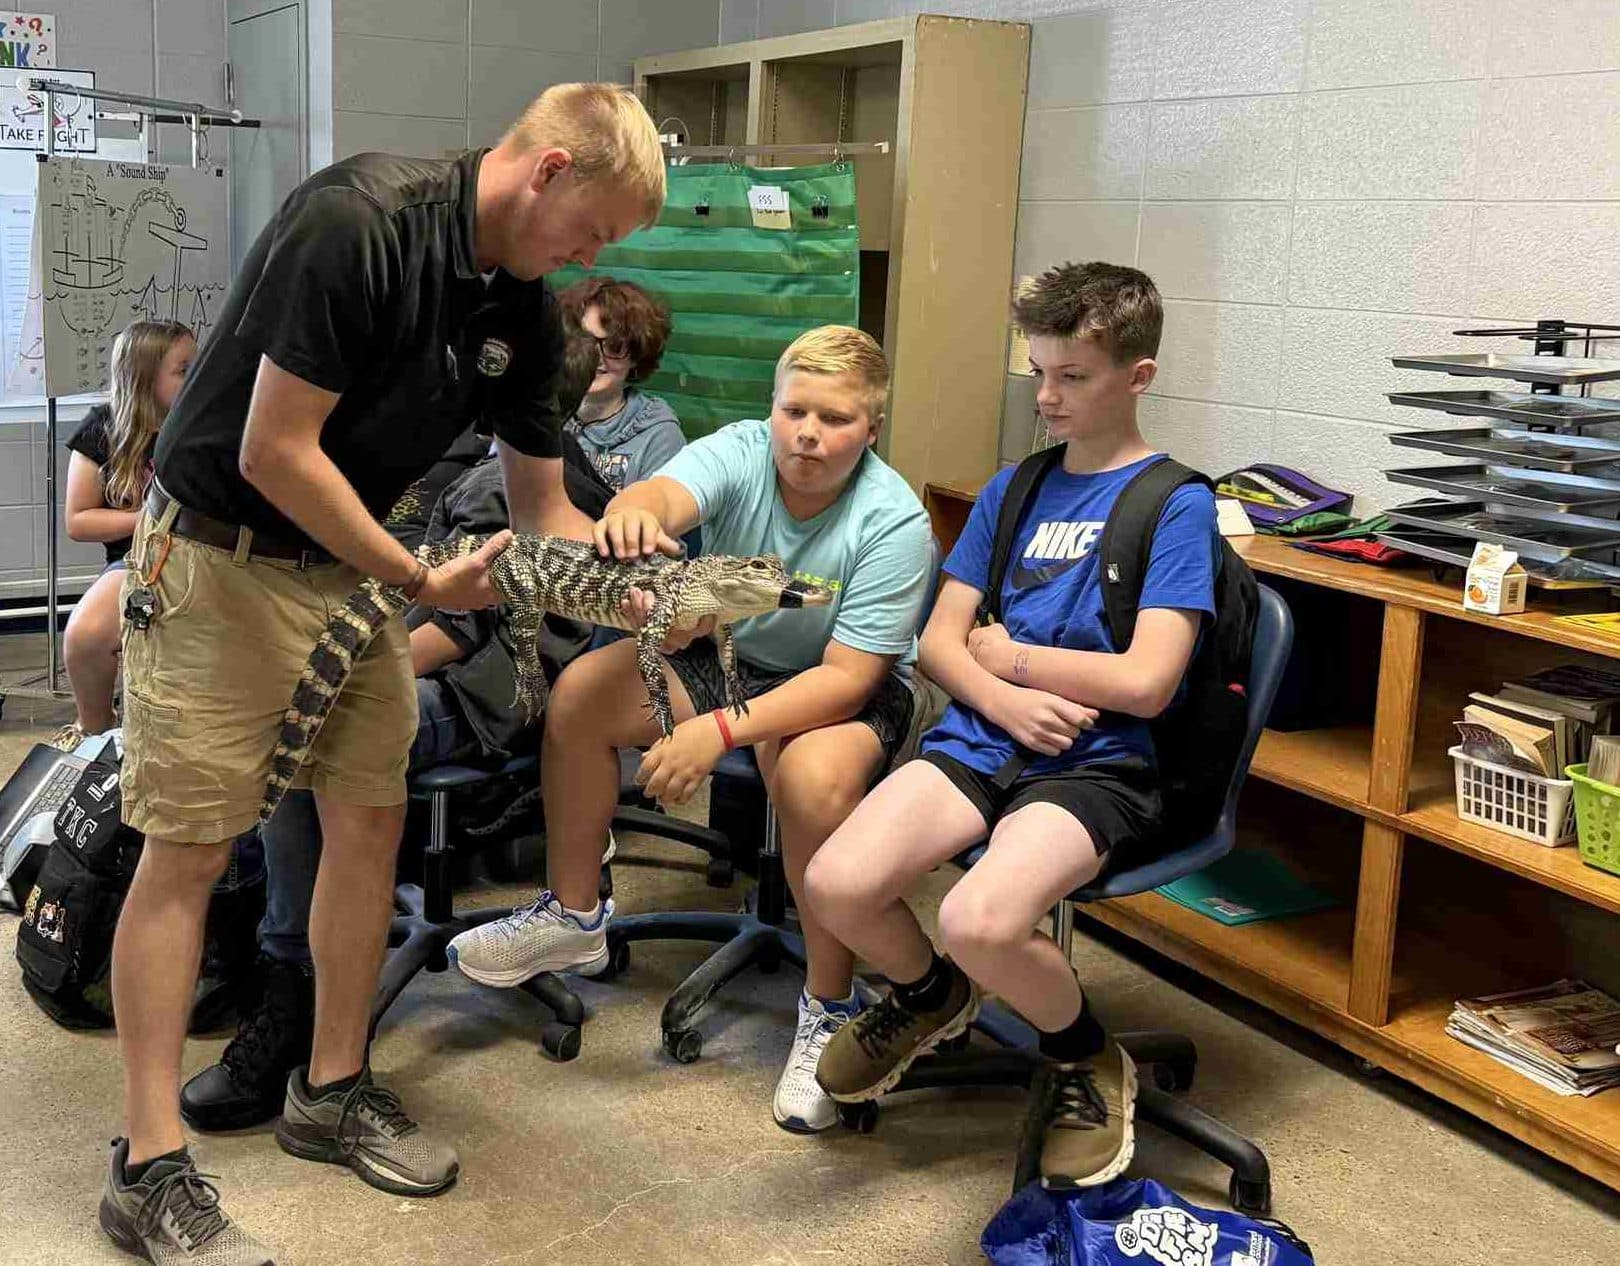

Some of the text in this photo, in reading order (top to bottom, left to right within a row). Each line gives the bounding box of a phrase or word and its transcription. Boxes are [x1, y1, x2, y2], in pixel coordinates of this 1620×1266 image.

[0, 124, 90, 144] TAKE FGHT
[106, 163, 114, 177] A
[1023, 521, 1106, 560] NIKE
